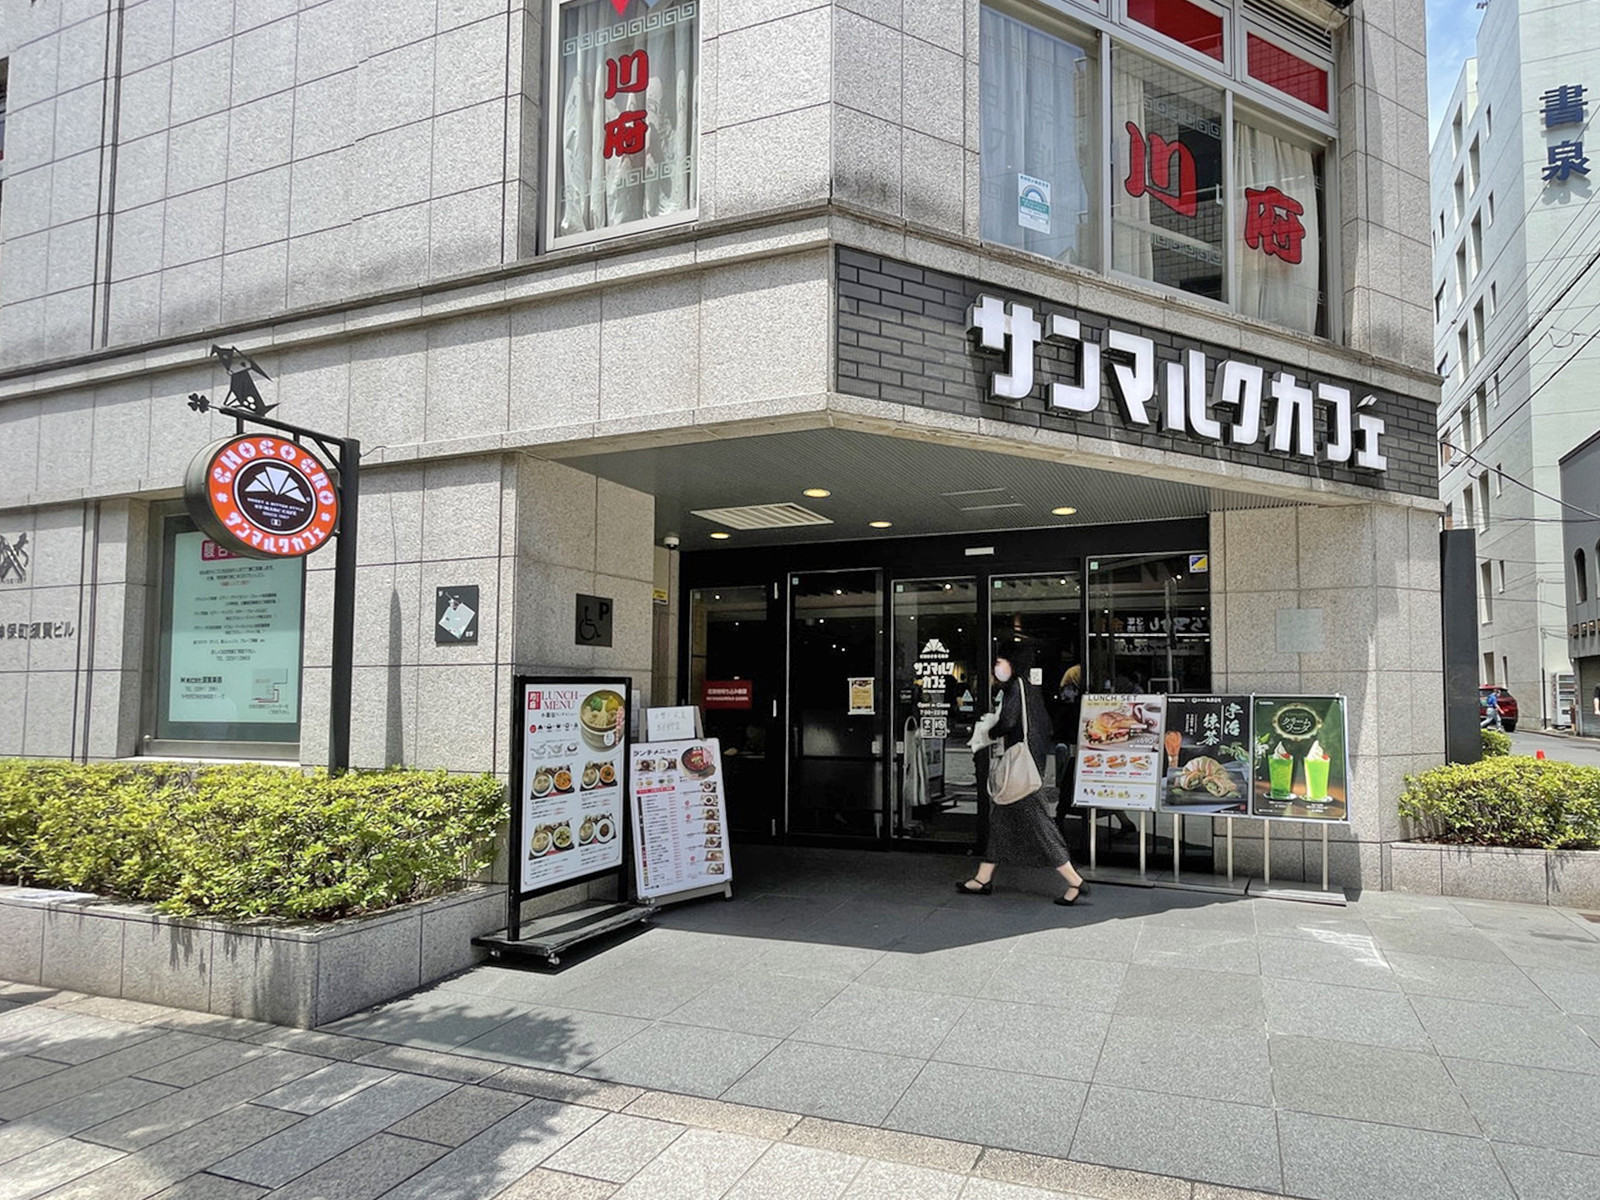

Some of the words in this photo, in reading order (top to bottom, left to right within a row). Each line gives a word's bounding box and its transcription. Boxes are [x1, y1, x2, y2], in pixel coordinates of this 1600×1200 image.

[1539, 84, 1591, 181] 書泉
[971, 293, 1388, 474] サンマルクカフェ
[225, 511, 326, 553] サンマルクカフェ
[599, 601, 610, 621] P
[913, 662, 955, 676] サンマルク
[922, 675, 946, 689] カフェ
[541, 690, 579, 700] LUNCH
[543, 700, 576, 710] MENU
